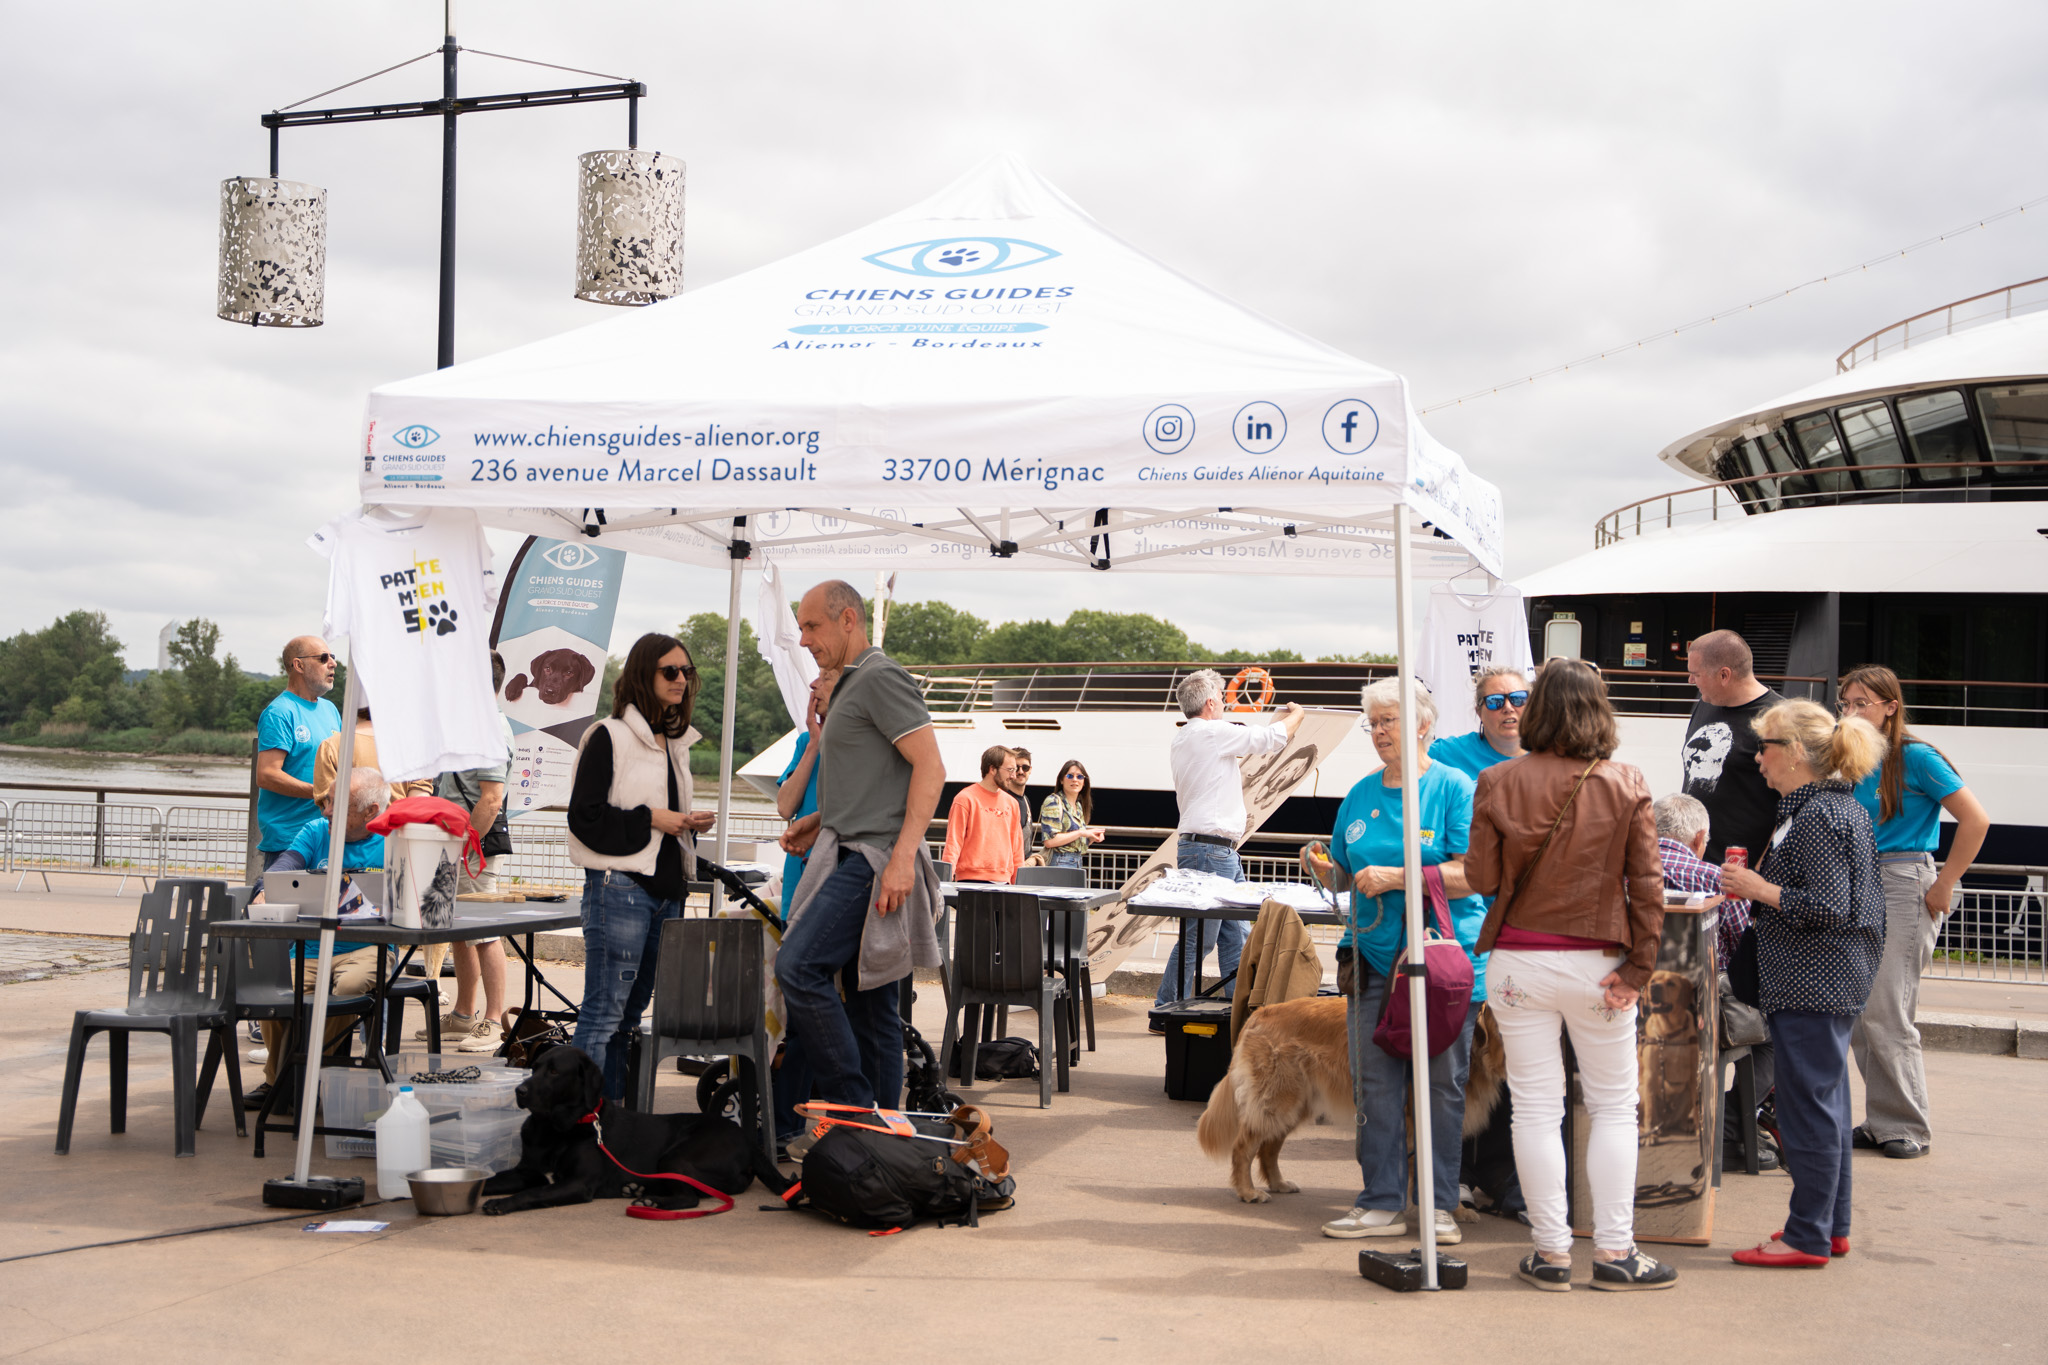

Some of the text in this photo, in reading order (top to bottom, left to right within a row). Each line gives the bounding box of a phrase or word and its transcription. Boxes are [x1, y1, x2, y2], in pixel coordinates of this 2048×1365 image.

[805, 286, 1075, 301] CHIENS GUIDES
[795, 301, 1069, 317] GRAND SUD OUEST
[845, 324, 899, 333] FORCE
[771, 340, 876, 350] Alienor
[911, 338, 1044, 348] Bordeaux
[473, 424, 821, 455] www.chiensguides-alienor.org
[382, 454, 446, 462] CHIENS GUIDES
[470, 457, 817, 482] 236 avenue Marcel Dassault
[882, 456, 1105, 491] 33700 Mérignac
[1137, 463, 1385, 485] Chiens Guides Aliénor Aquitaine
[529, 575, 604, 589] CHIENS GUIDES
[528, 586, 603, 598] GRAND SUD OUEST
[1457, 630, 1494, 646] PATTE
